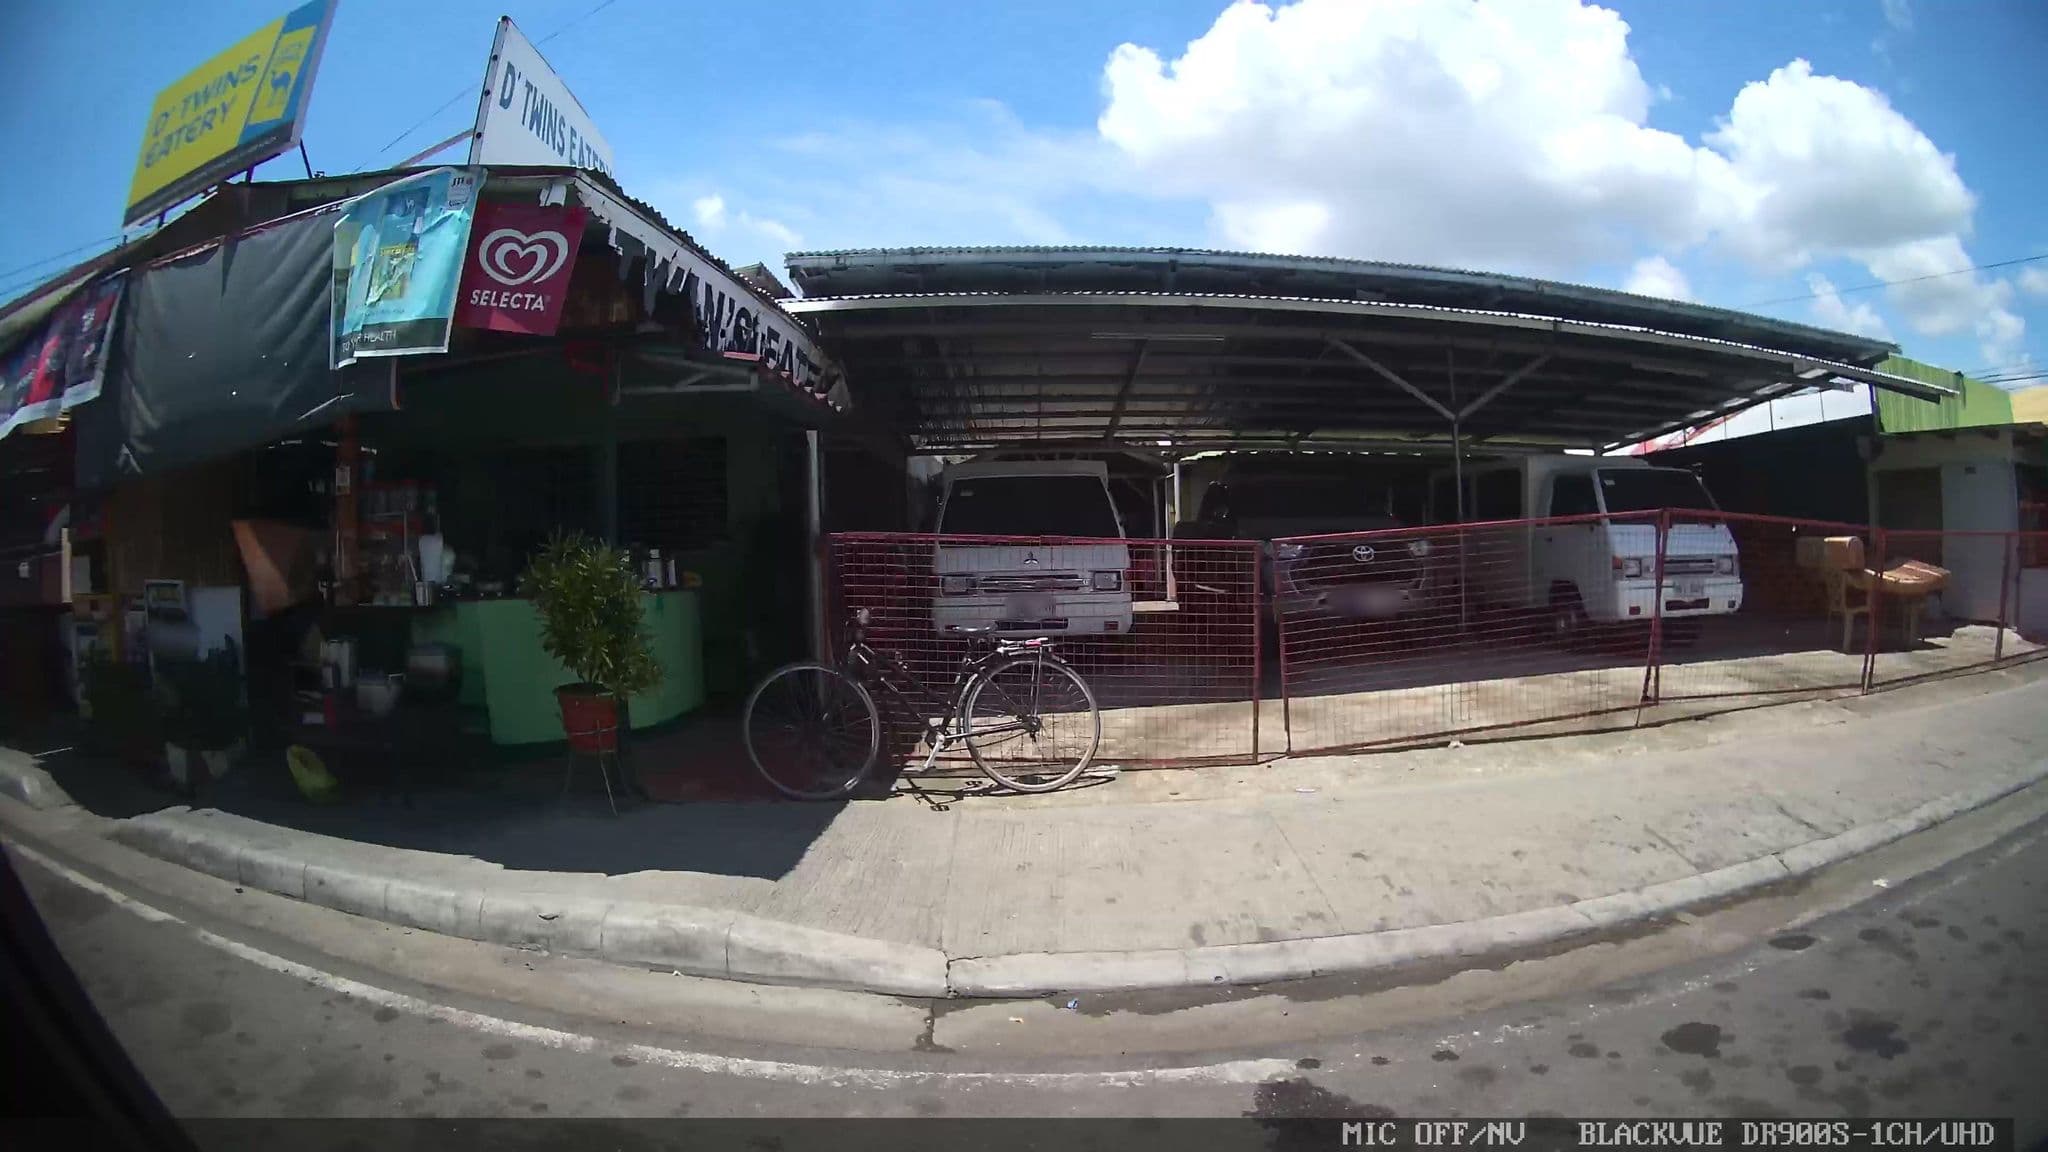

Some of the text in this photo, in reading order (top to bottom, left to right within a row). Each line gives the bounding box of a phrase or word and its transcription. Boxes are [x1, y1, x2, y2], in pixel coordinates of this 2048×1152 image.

[181, 53, 261, 119] TWINS
[498, 60, 522, 110] D'
[521, 79, 566, 158] TWINS
[144, 93, 239, 169] EATERY
[470, 288, 545, 312] SELECTA
